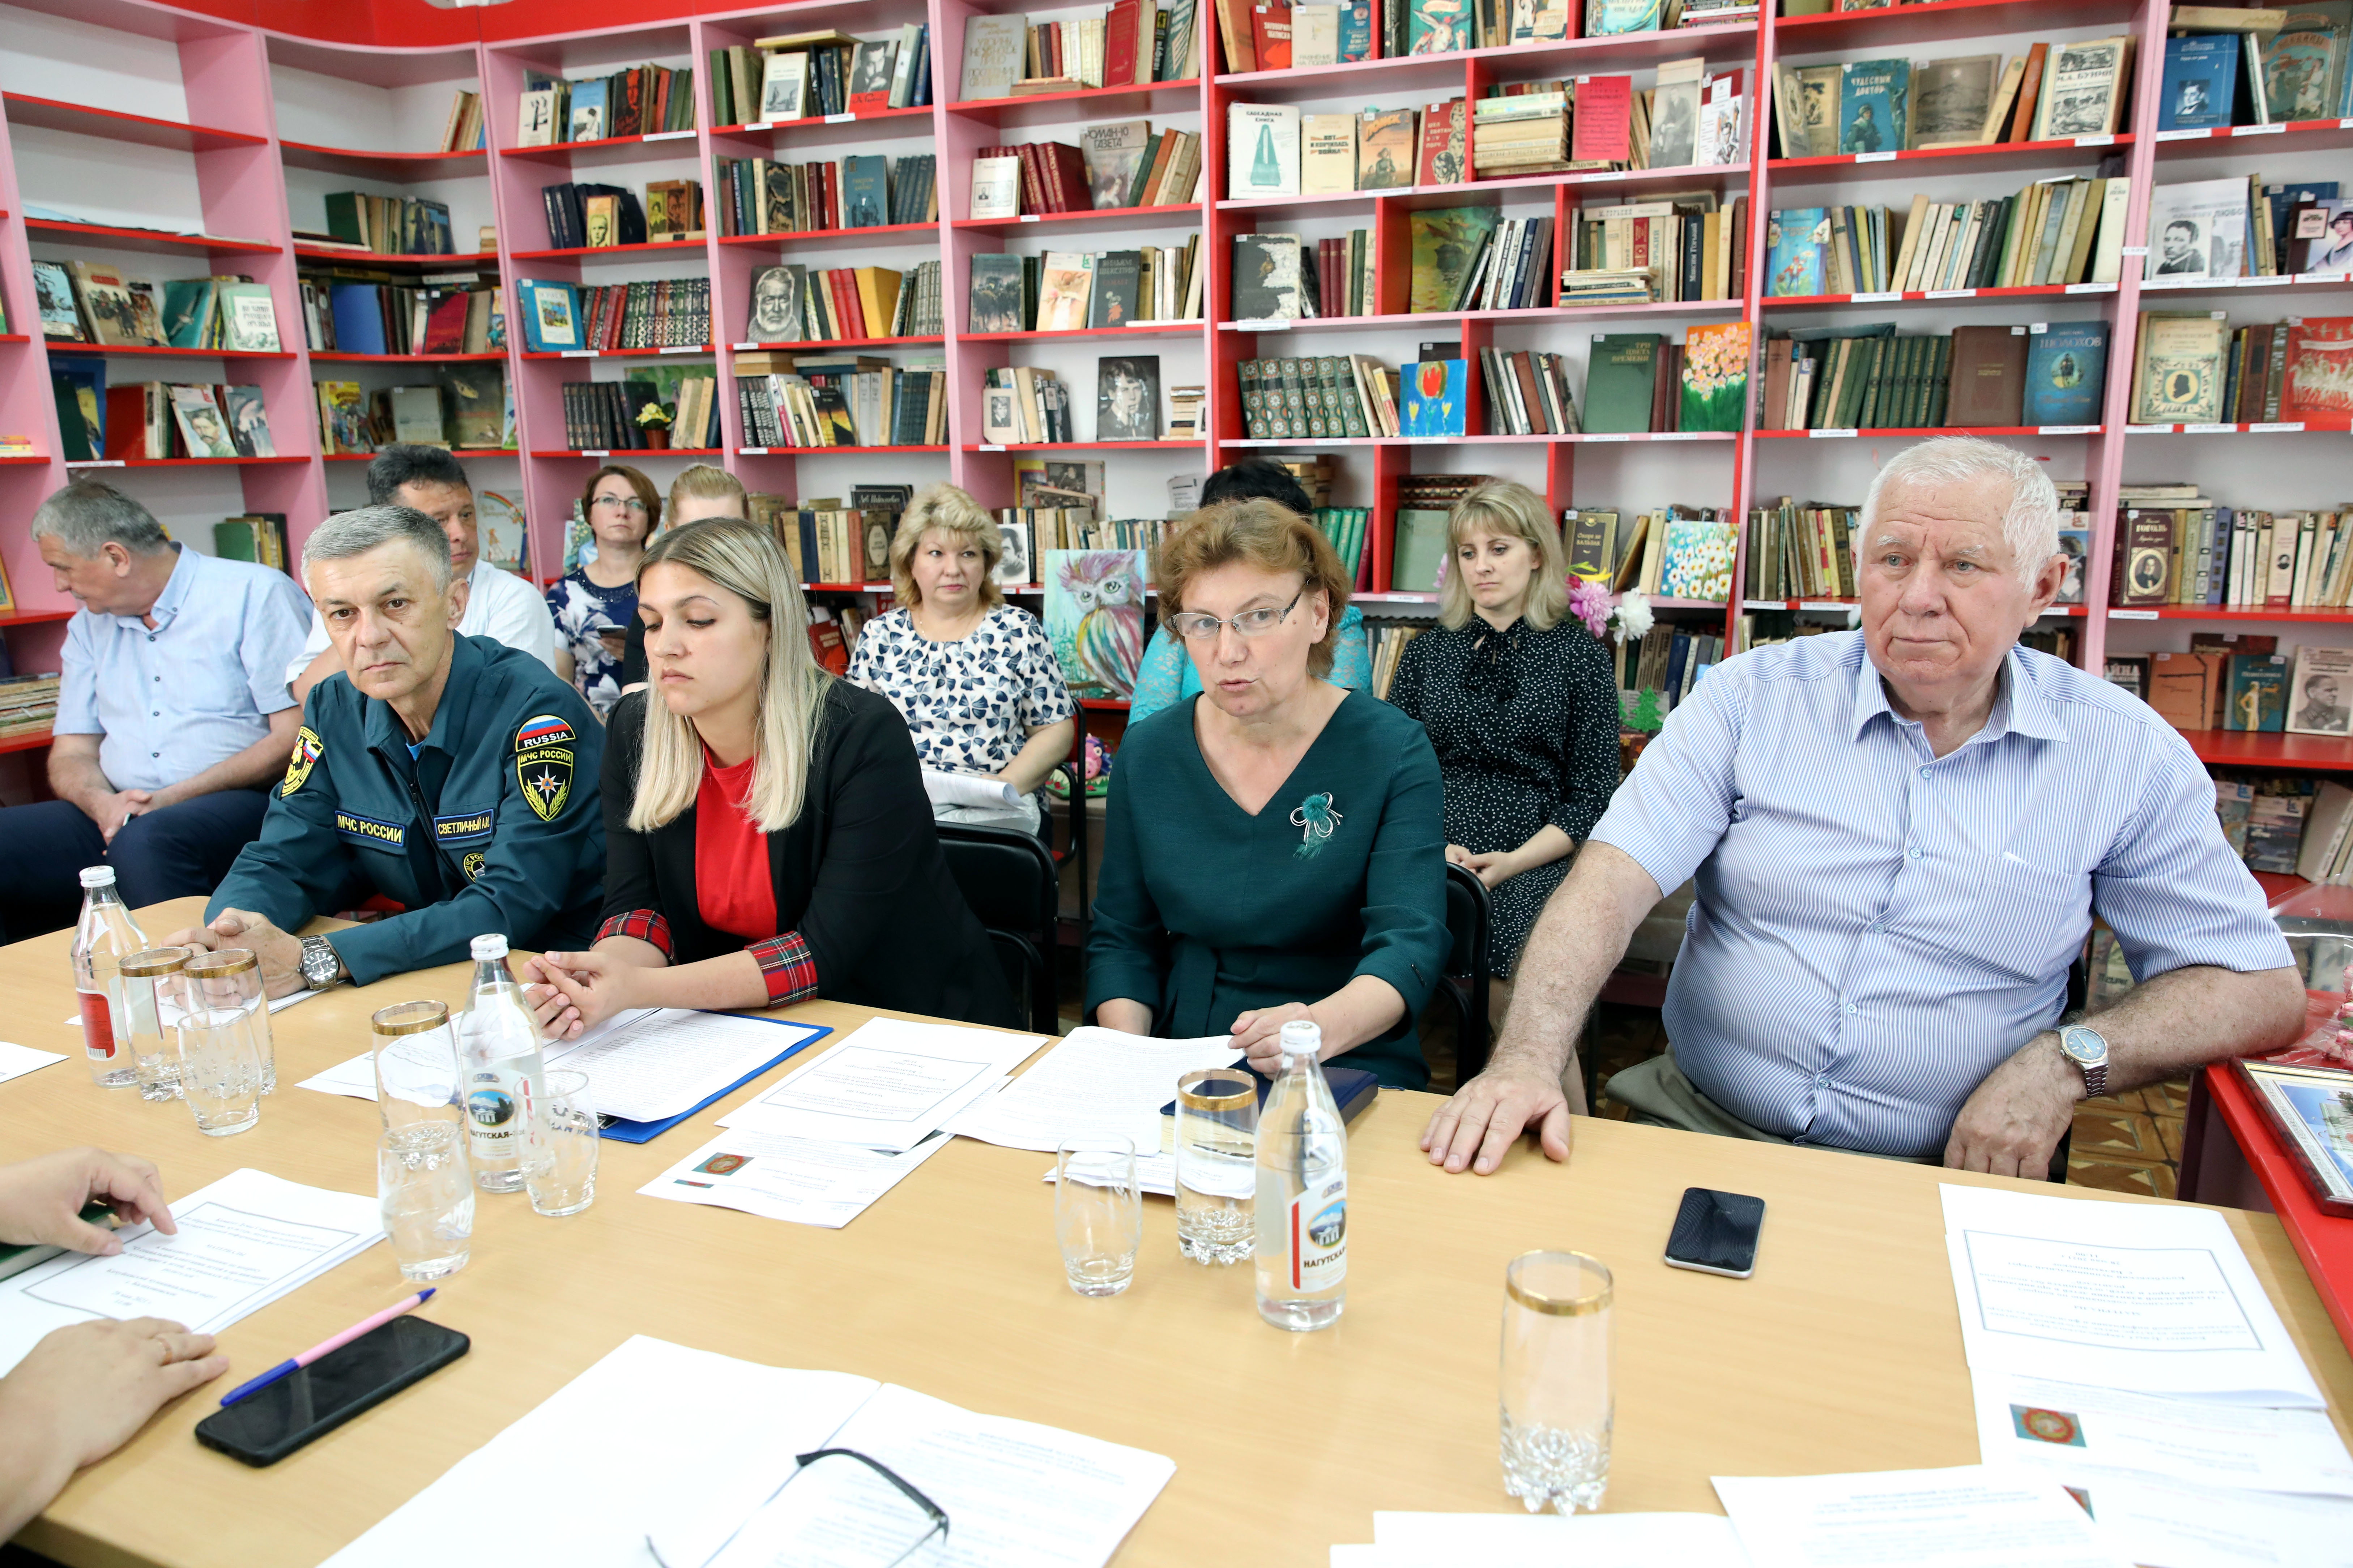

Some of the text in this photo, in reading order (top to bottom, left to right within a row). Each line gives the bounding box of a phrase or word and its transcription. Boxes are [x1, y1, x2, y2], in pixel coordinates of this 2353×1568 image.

[1851, 75, 1891, 86] ЧУДЕСНЫЙ
[1854, 85, 1886, 96] ДОКТОР
[1094, 138, 1122, 149] ГАЗЕТА
[2039, 336, 2102, 349] ШОЛОХОВ
[2136, 524, 2168, 533] ГОГОЛЬ
[524, 731, 568, 747] RUSSIA
[520, 750, 571, 763] МЧС РОССИИ
[338, 815, 402, 843] МЧС РОССИИ
[438, 816, 482, 835] СВЕТЛИЧНЫЙ
